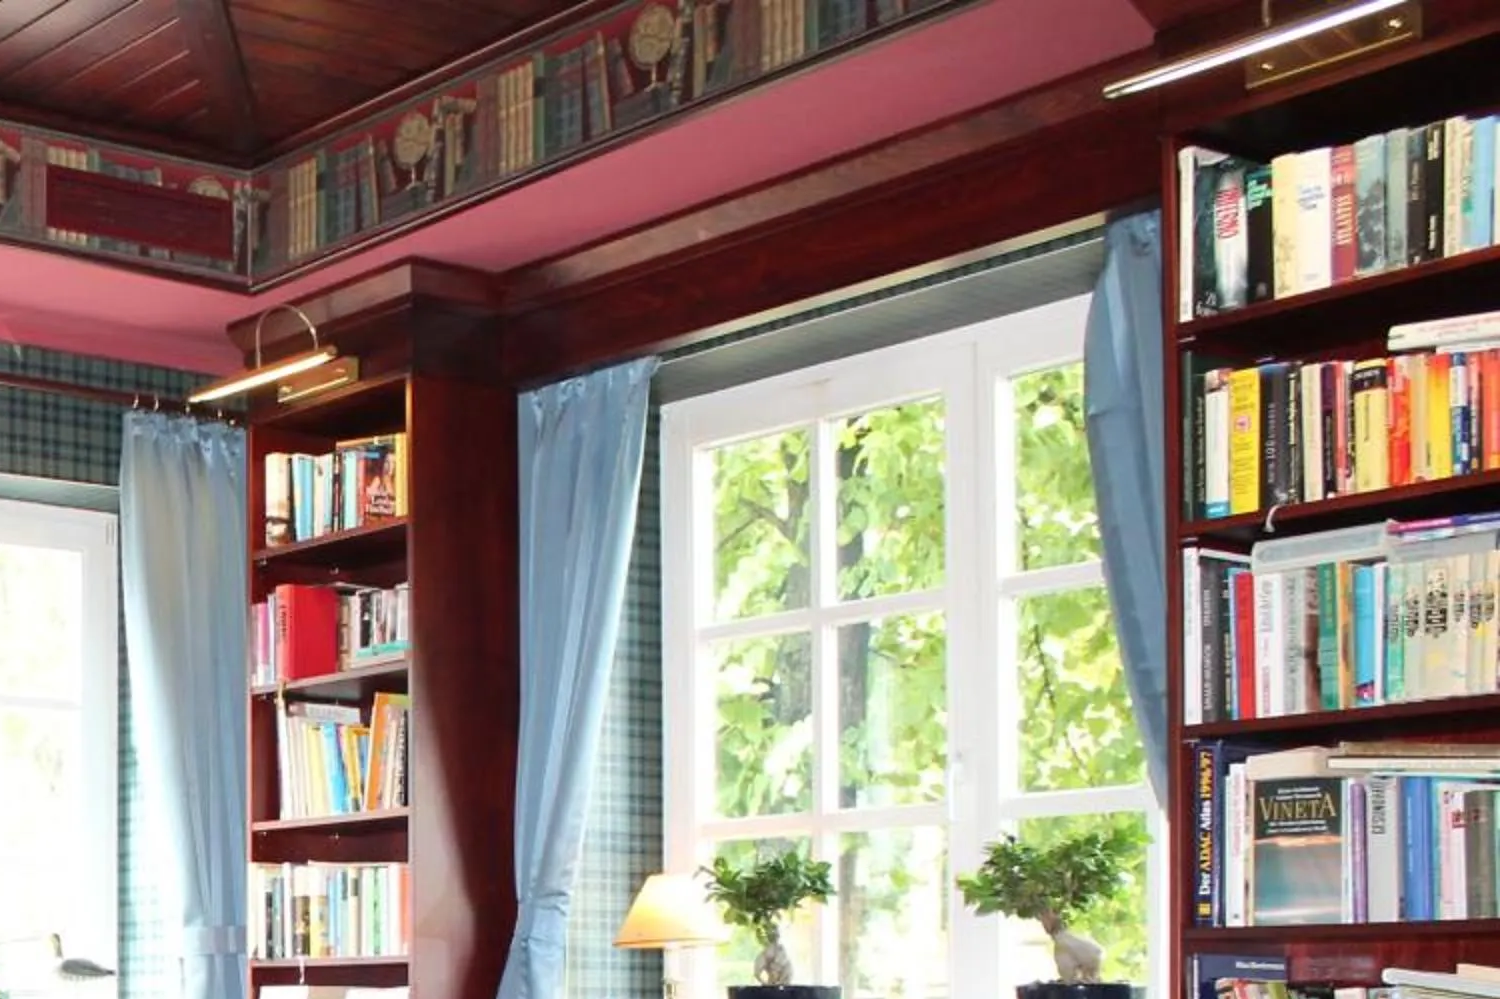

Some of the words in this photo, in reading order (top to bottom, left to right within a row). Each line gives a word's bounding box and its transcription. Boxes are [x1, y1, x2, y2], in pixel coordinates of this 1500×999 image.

[1199, 800, 1212, 830] Atlas
[1259, 791, 1337, 821] VINETA
[1199, 831, 1212, 871] ADAC
[1199, 872, 1211, 895] Der
